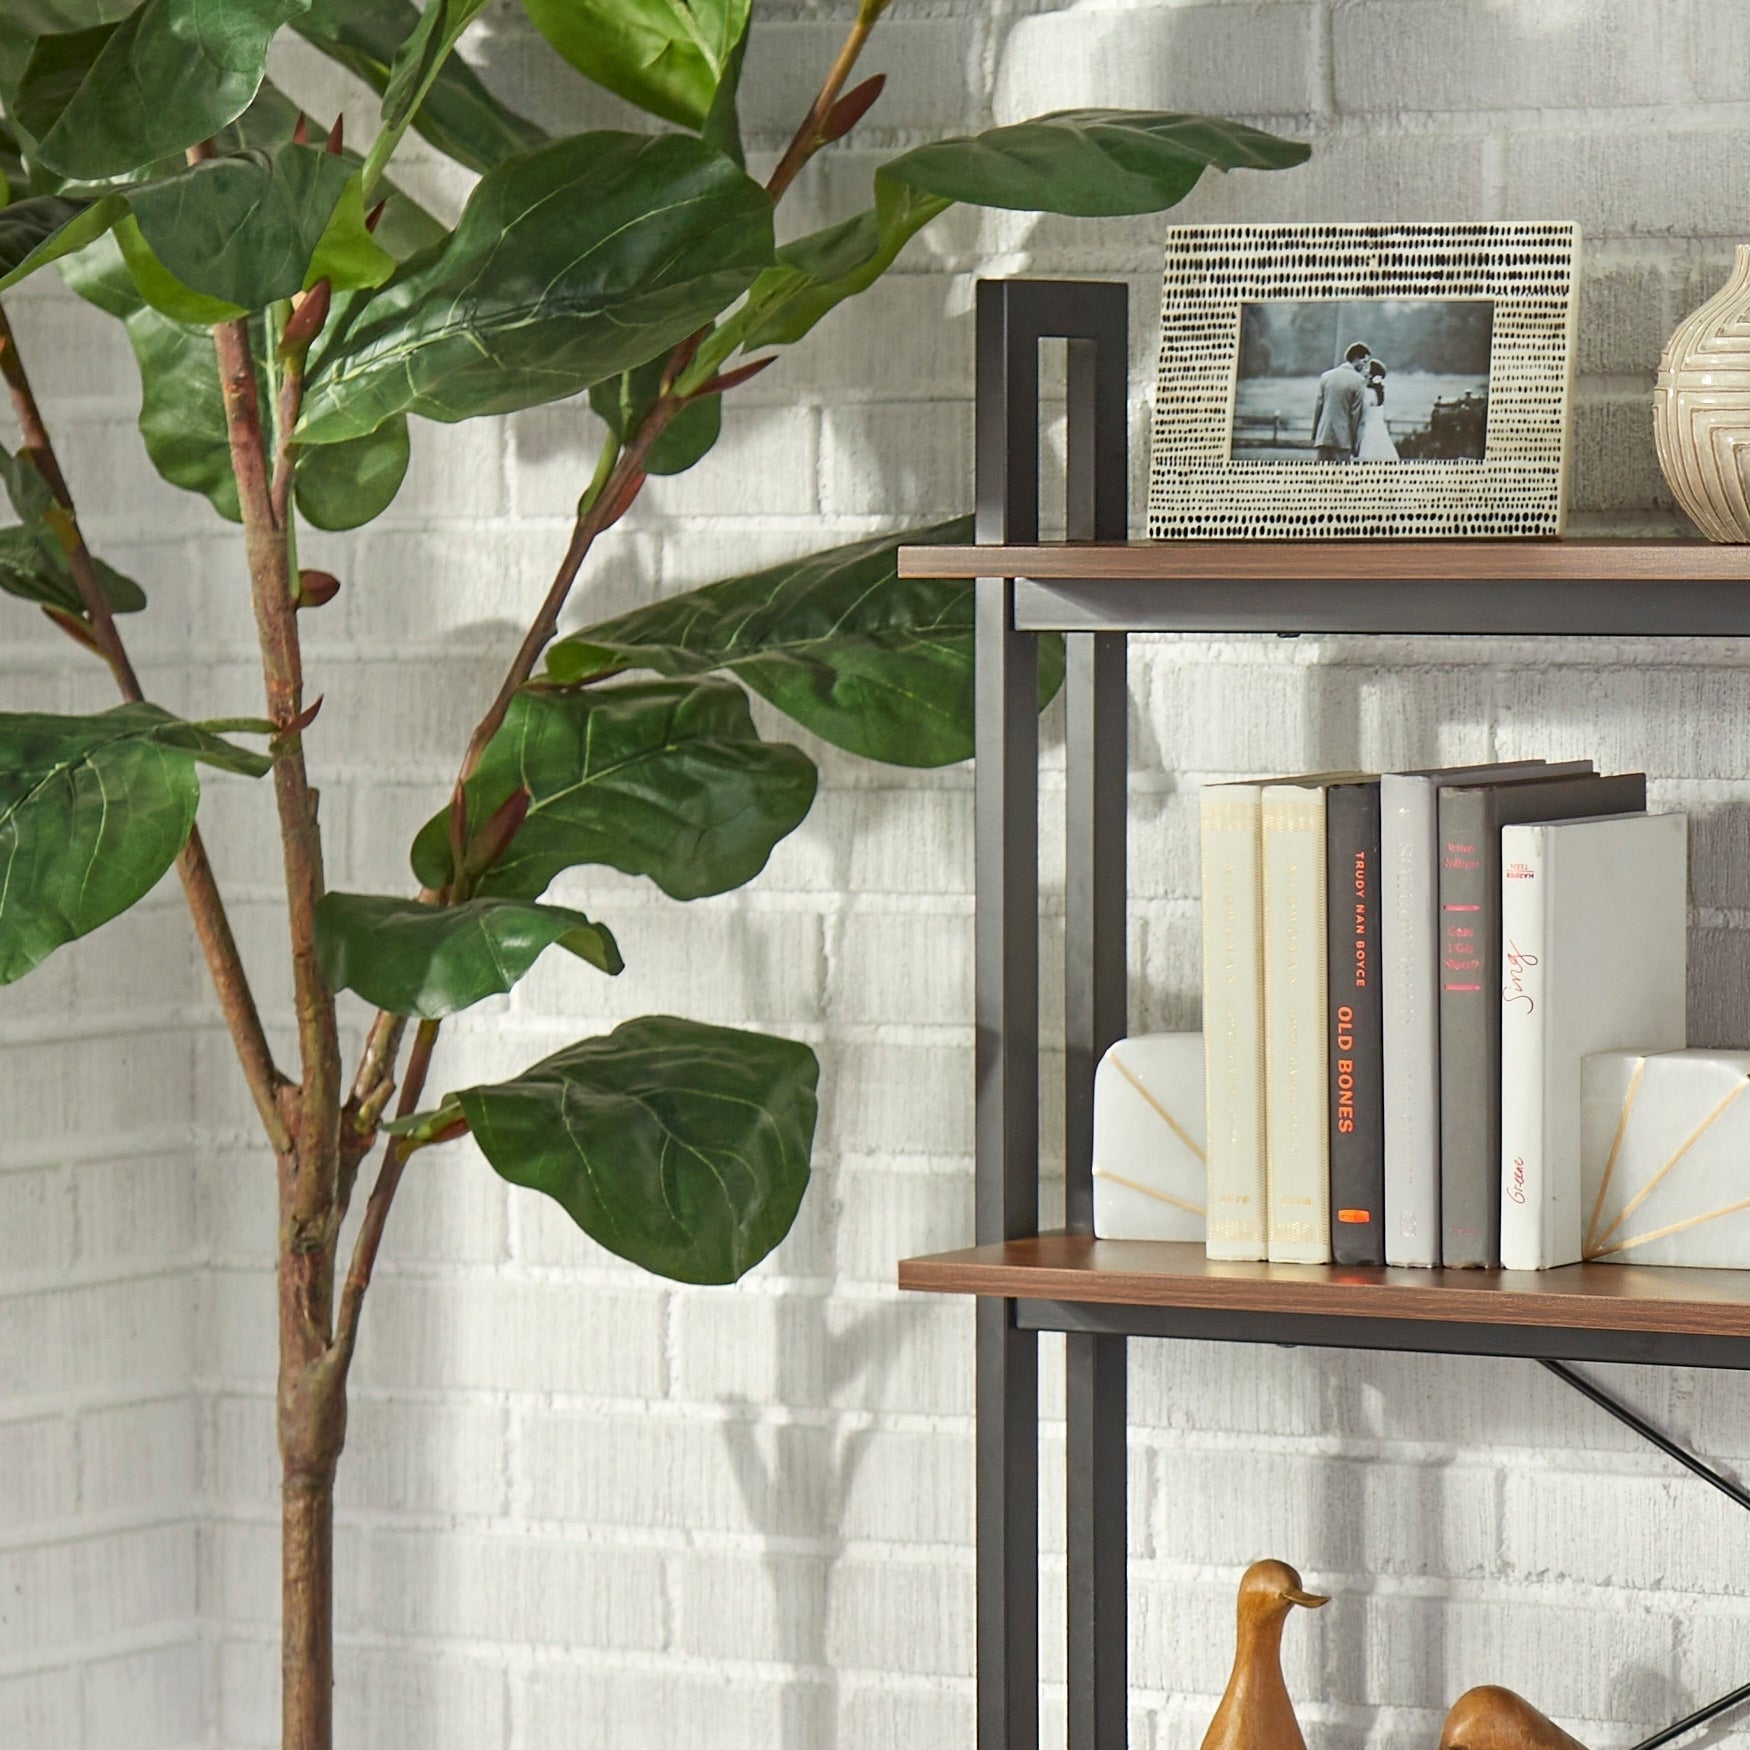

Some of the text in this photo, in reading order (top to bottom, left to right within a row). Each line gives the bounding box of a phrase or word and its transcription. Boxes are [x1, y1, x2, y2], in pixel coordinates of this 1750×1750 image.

[1354, 852, 1367, 988] TRUDY NAN BOYCE
[1502, 938, 1539, 1015] Sing
[1336, 1005, 1355, 1134] OLD BONES
